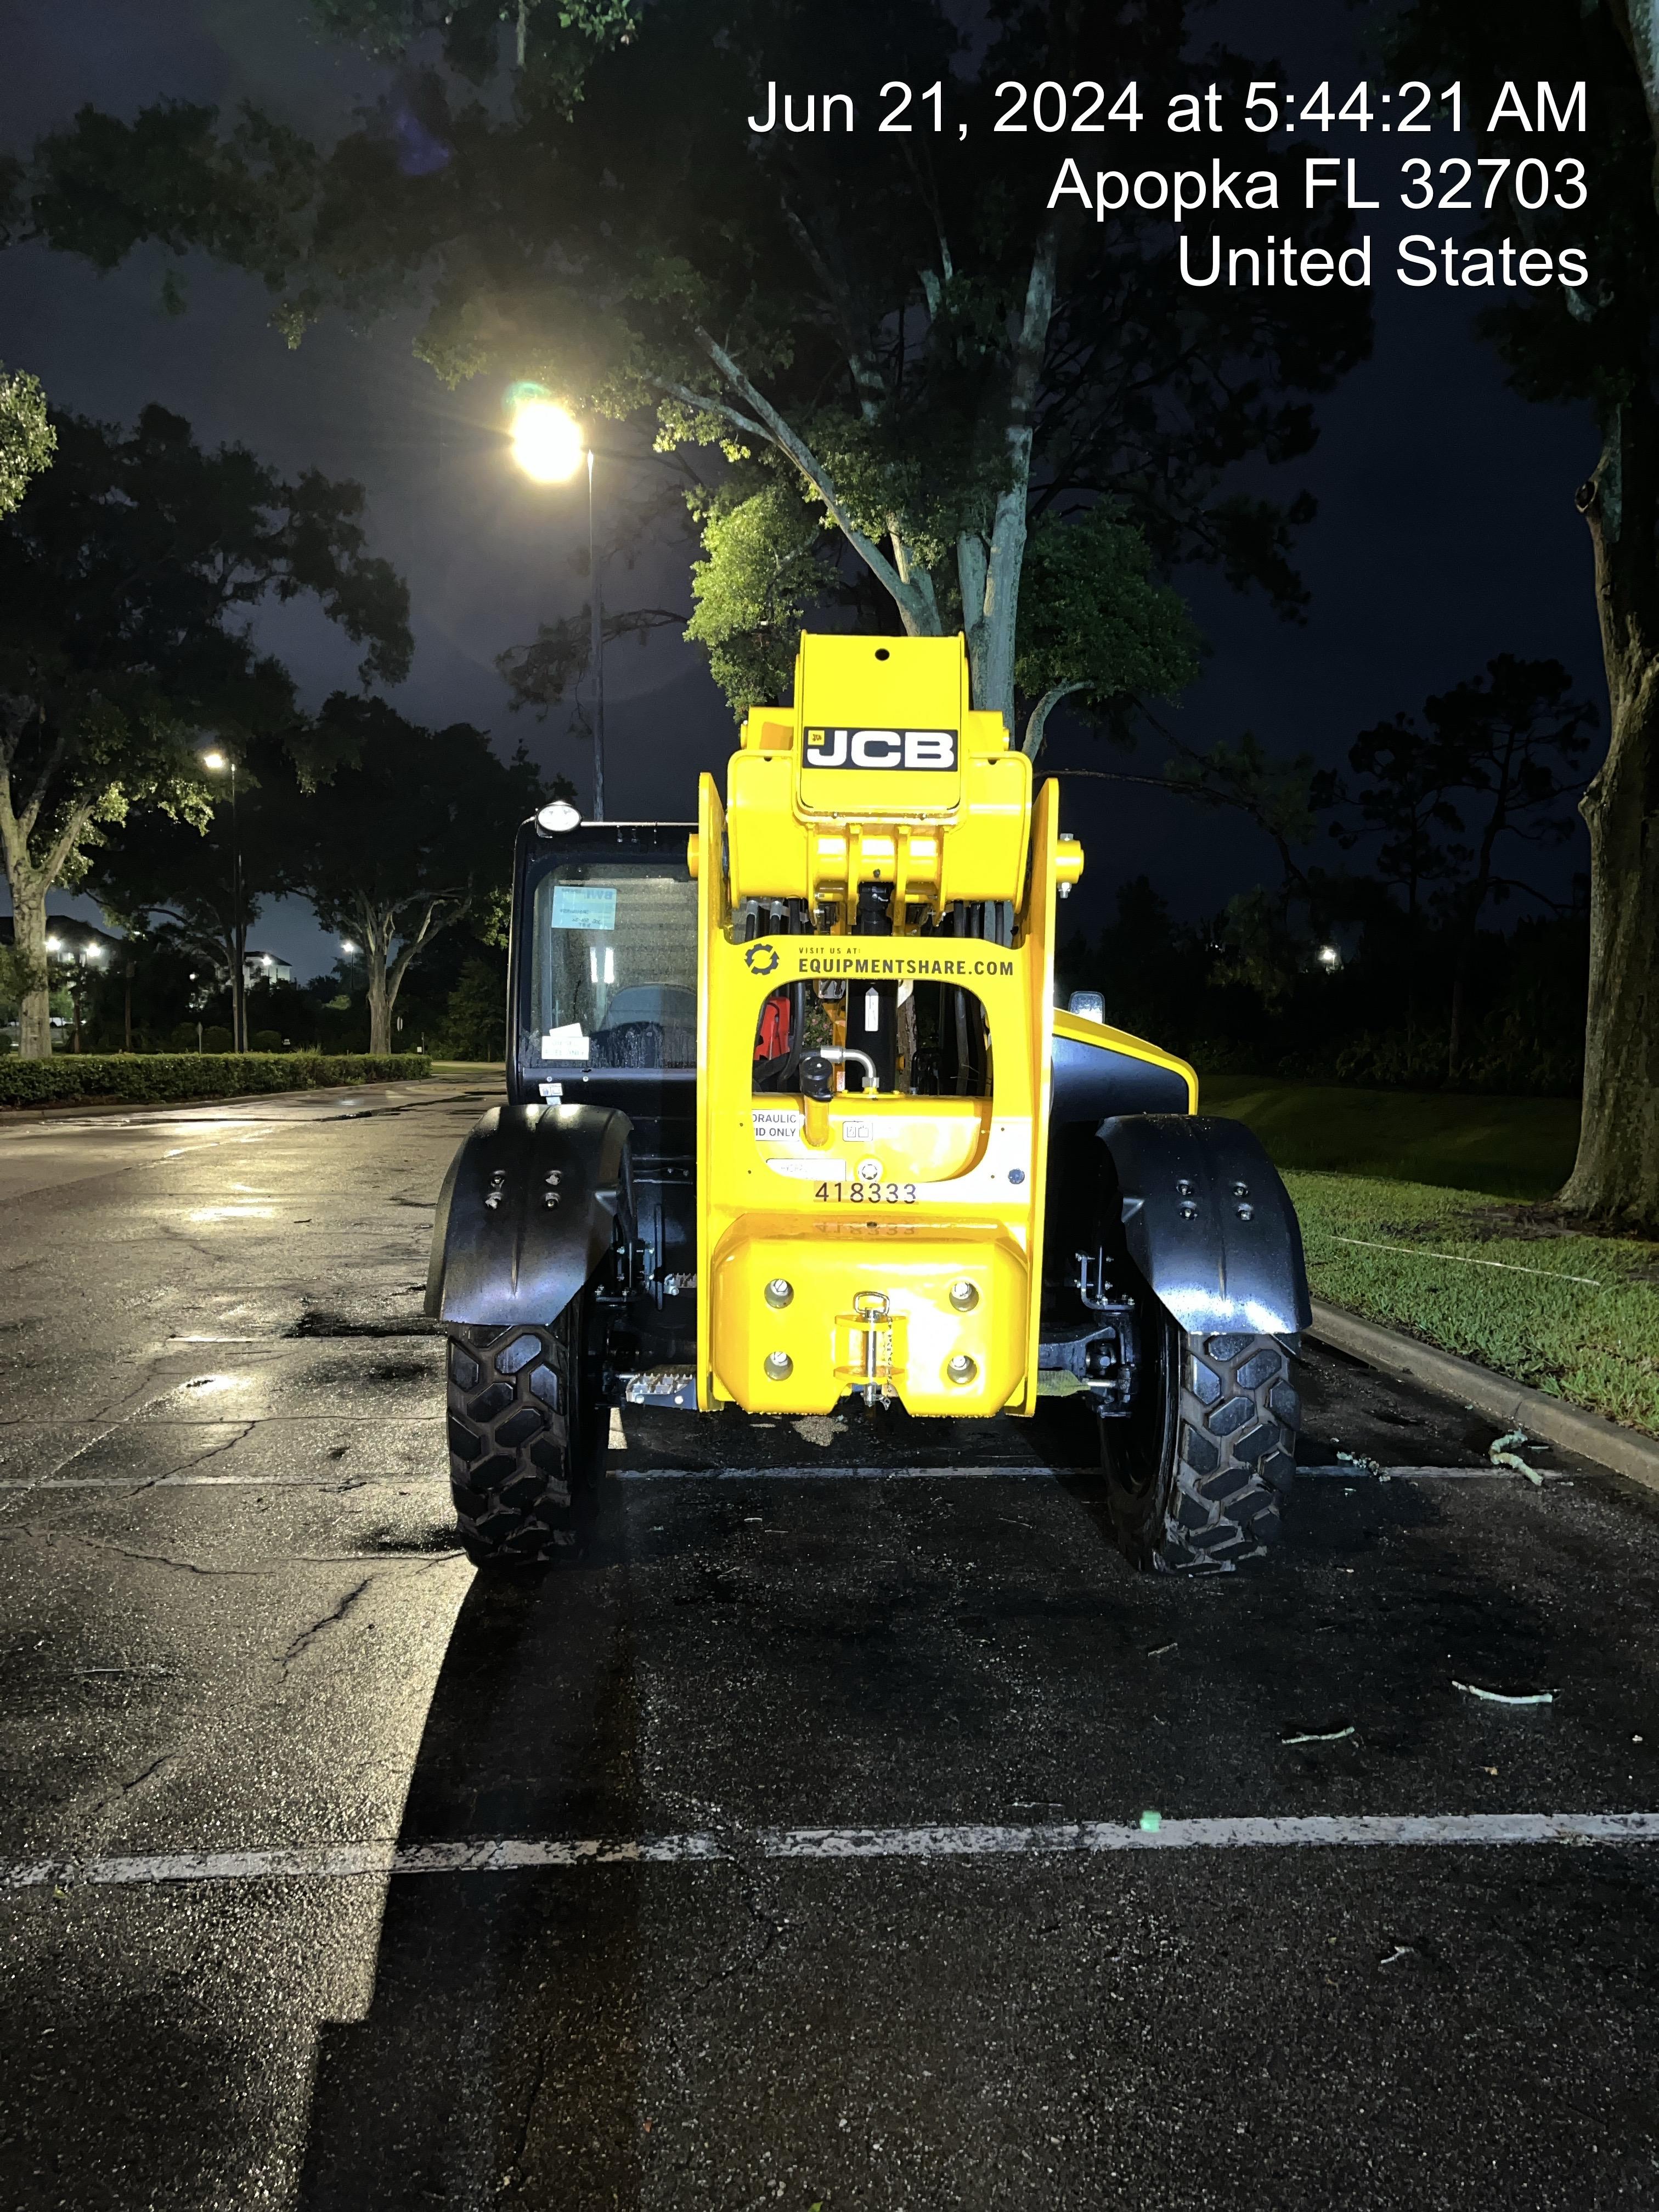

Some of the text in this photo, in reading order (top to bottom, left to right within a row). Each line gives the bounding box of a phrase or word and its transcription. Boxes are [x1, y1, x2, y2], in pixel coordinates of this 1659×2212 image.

[807, 730, 955, 768] JCB
[799, 958, 1014, 976] EQUIPMENTSHARE.COM
[769, 1127, 796, 1137] ONLY
[815, 1182, 917, 1204] 418333
